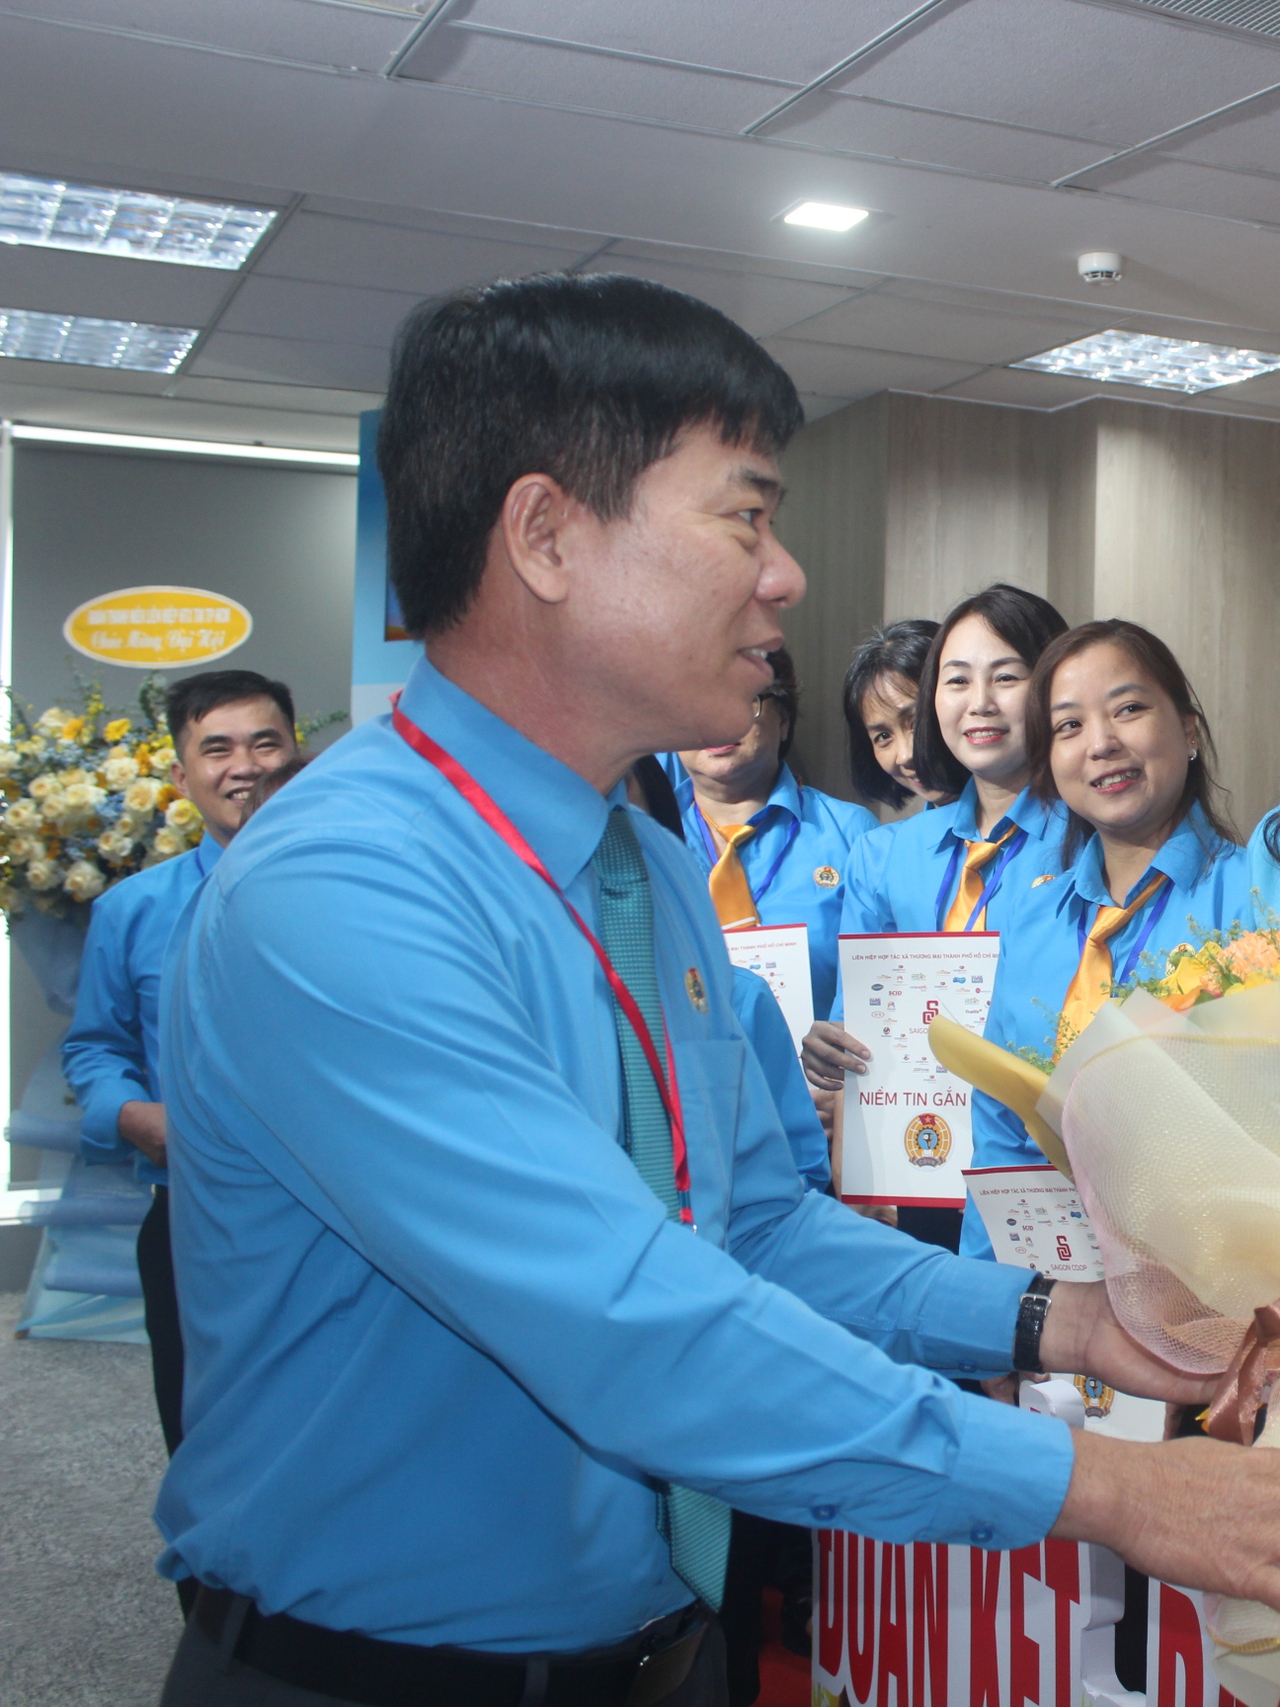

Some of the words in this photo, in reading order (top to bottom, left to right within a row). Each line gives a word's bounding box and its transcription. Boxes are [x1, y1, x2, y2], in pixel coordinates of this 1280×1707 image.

[860, 1086, 897, 1106] NIỀM
[903, 1092, 928, 1106] TIN
[932, 1086, 966, 1106] GẮN
